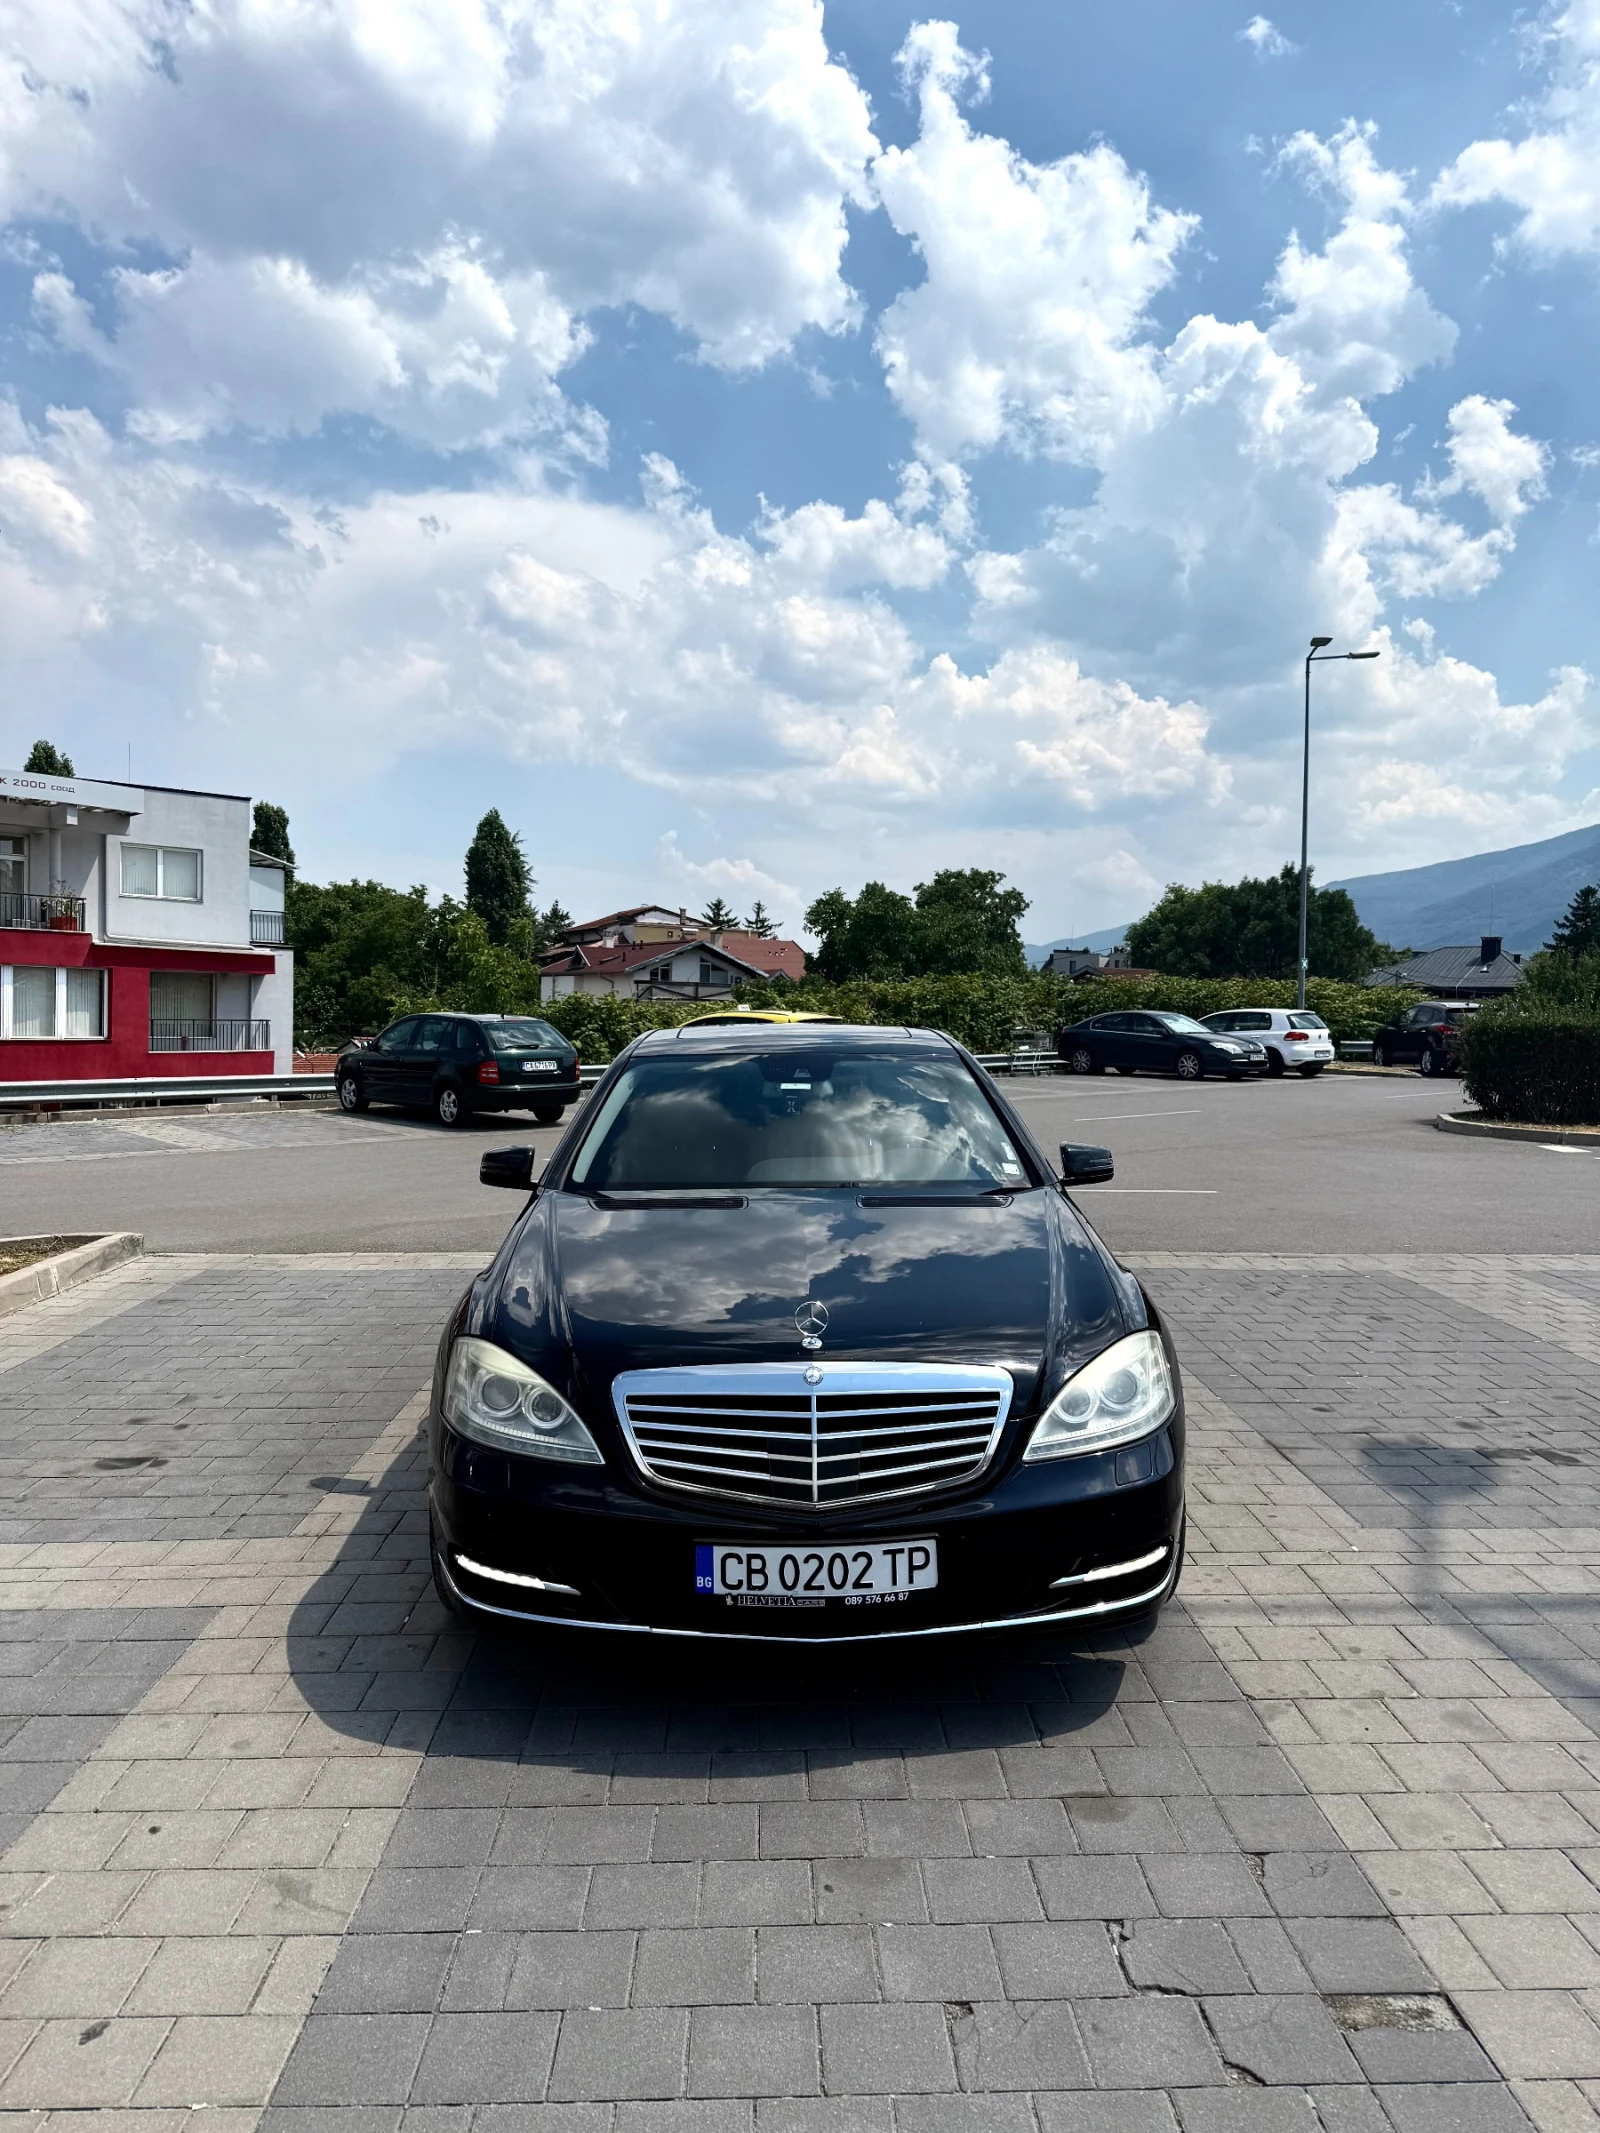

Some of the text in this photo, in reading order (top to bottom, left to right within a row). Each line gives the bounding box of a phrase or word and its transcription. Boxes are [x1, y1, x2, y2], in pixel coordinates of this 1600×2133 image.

[13, 779, 46, 789] 2000
[721, 1546, 931, 1591] CB 0202 TP
[696, 1576, 712, 1588] BG
[737, 1595, 797, 1605] HELVETIA
[845, 1596, 862, 1605] 089
[865, 1595, 882, 1604] 576
[884, 1593, 895, 1602] 66
[898, 1592, 909, 1601] 87
